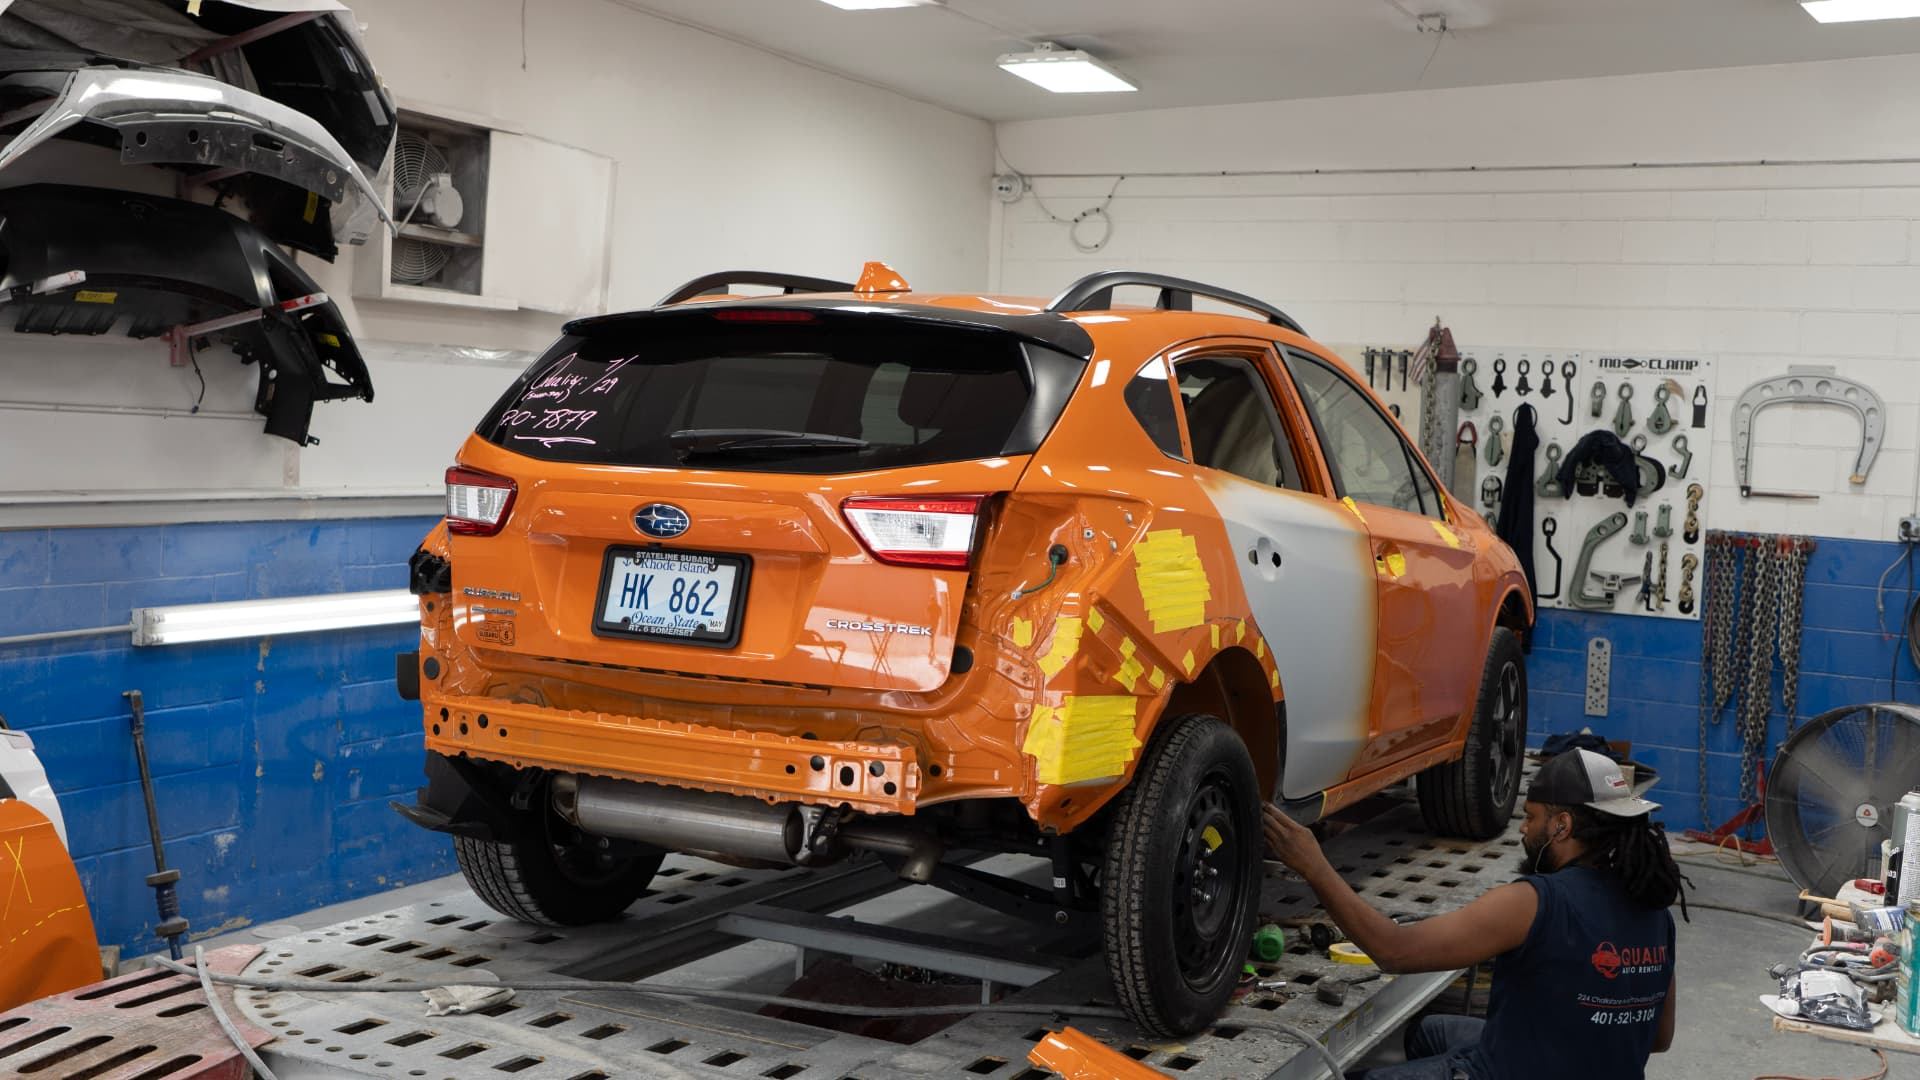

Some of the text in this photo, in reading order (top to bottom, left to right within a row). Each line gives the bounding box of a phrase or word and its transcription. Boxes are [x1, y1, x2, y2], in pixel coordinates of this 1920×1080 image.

[1649, 359, 1699, 370] CLAMP
[636, 551, 715, 564] STATELINE SUBARU
[640, 558, 710, 575] Rhode Island
[620, 572, 719, 617] HK 862
[631, 610, 700, 629] Ocean State
[826, 619, 932, 636] CROSSTREK
[650, 627, 695, 637] SOMERSET
[1621, 945, 1668, 966] QUALIT
[1622, 966, 1636, 974] AUTO
